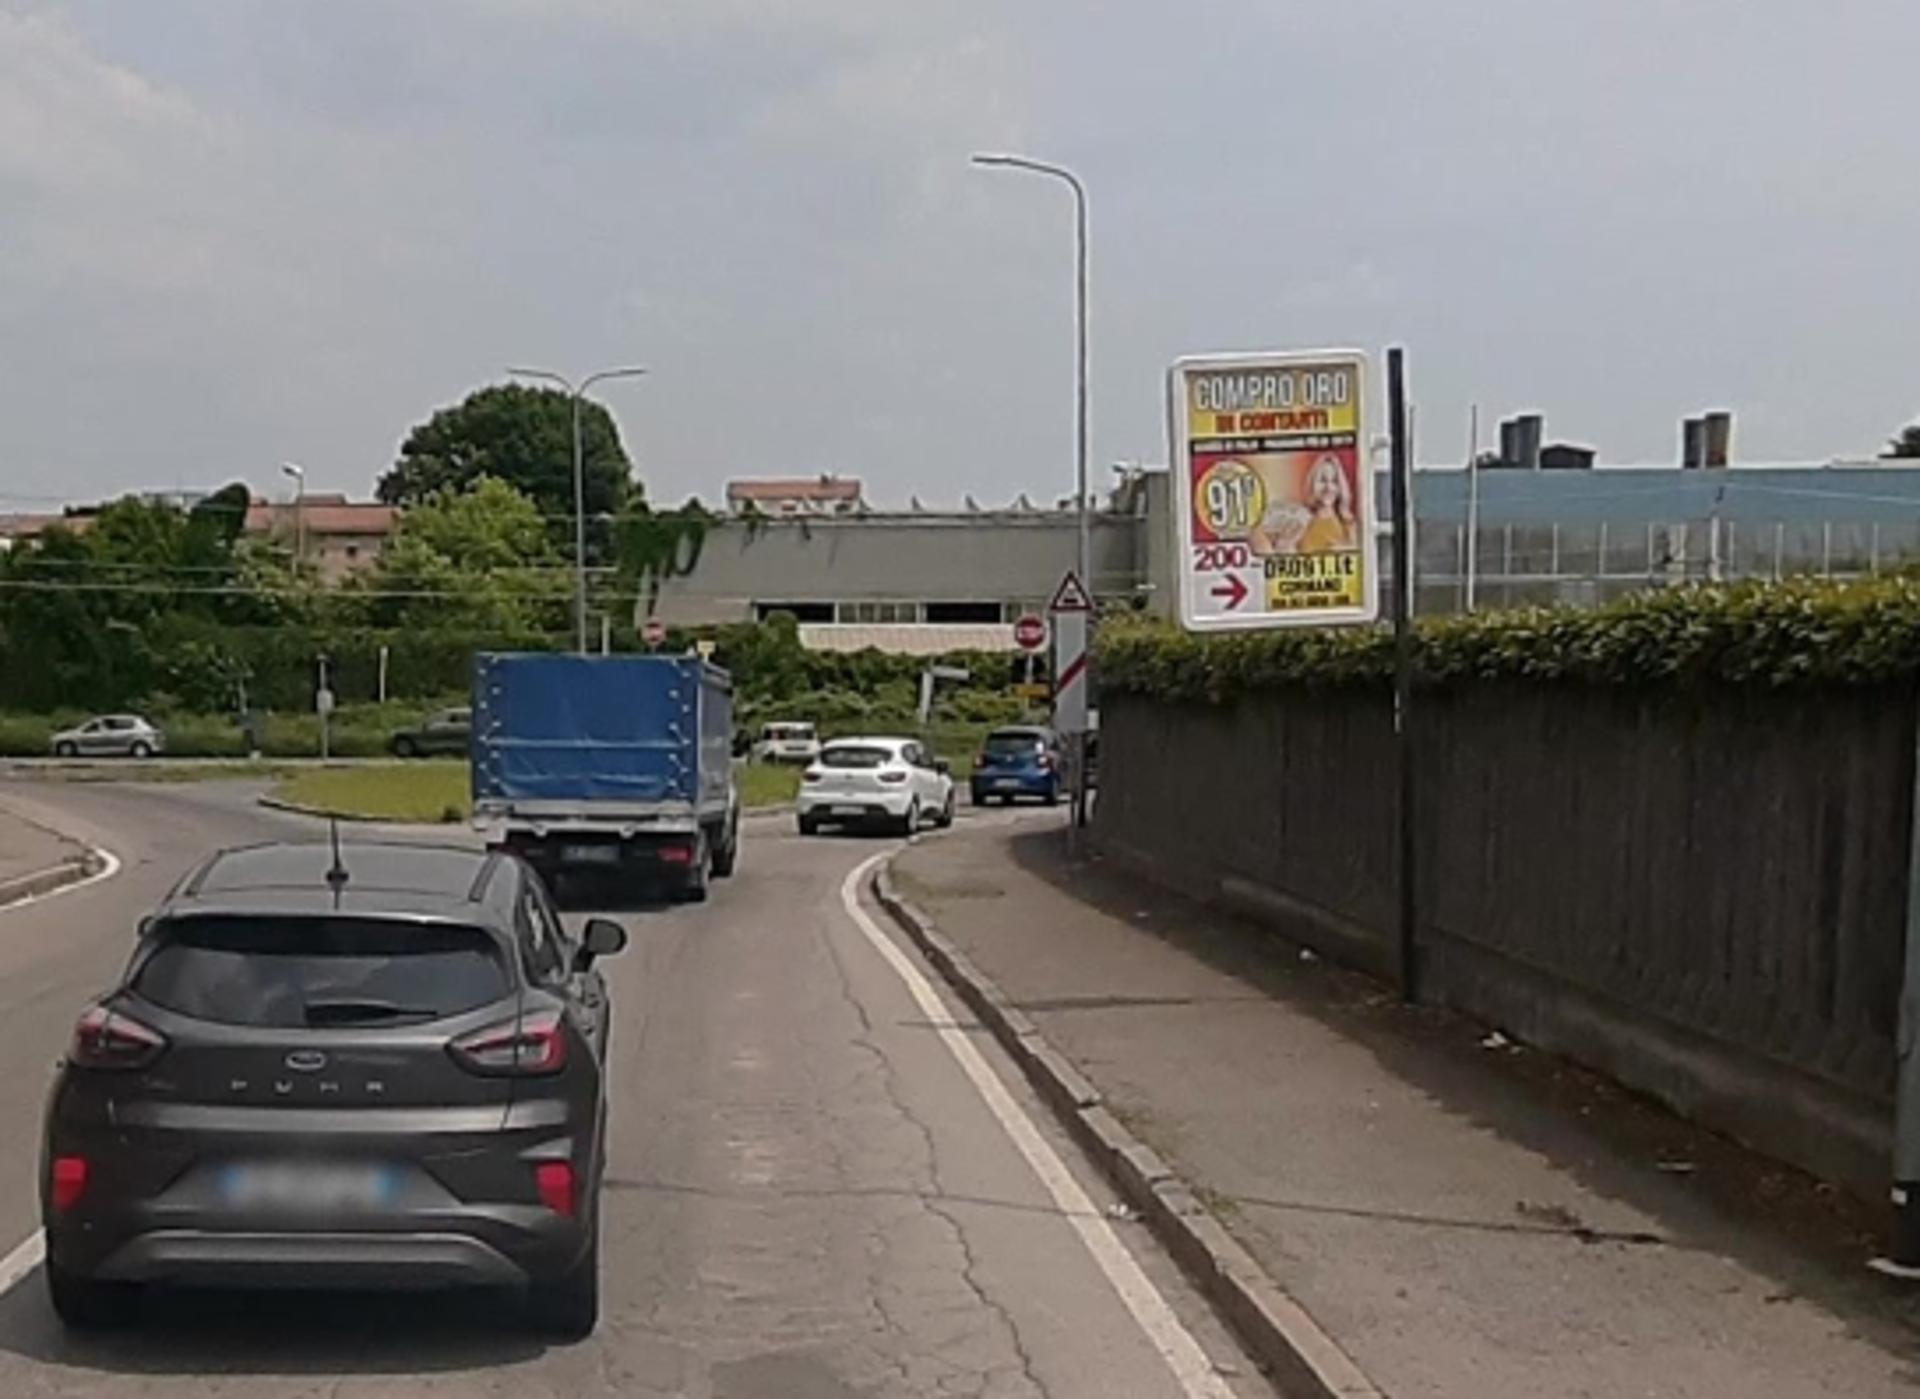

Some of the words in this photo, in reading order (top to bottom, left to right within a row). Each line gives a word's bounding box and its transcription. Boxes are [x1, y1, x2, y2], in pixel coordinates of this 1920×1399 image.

[1195, 374, 1294, 410] COMPRO
[1304, 372, 1347, 404] ORO
[1194, 546, 1248, 571] 200
[231, 1080, 383, 1093] PUMA
